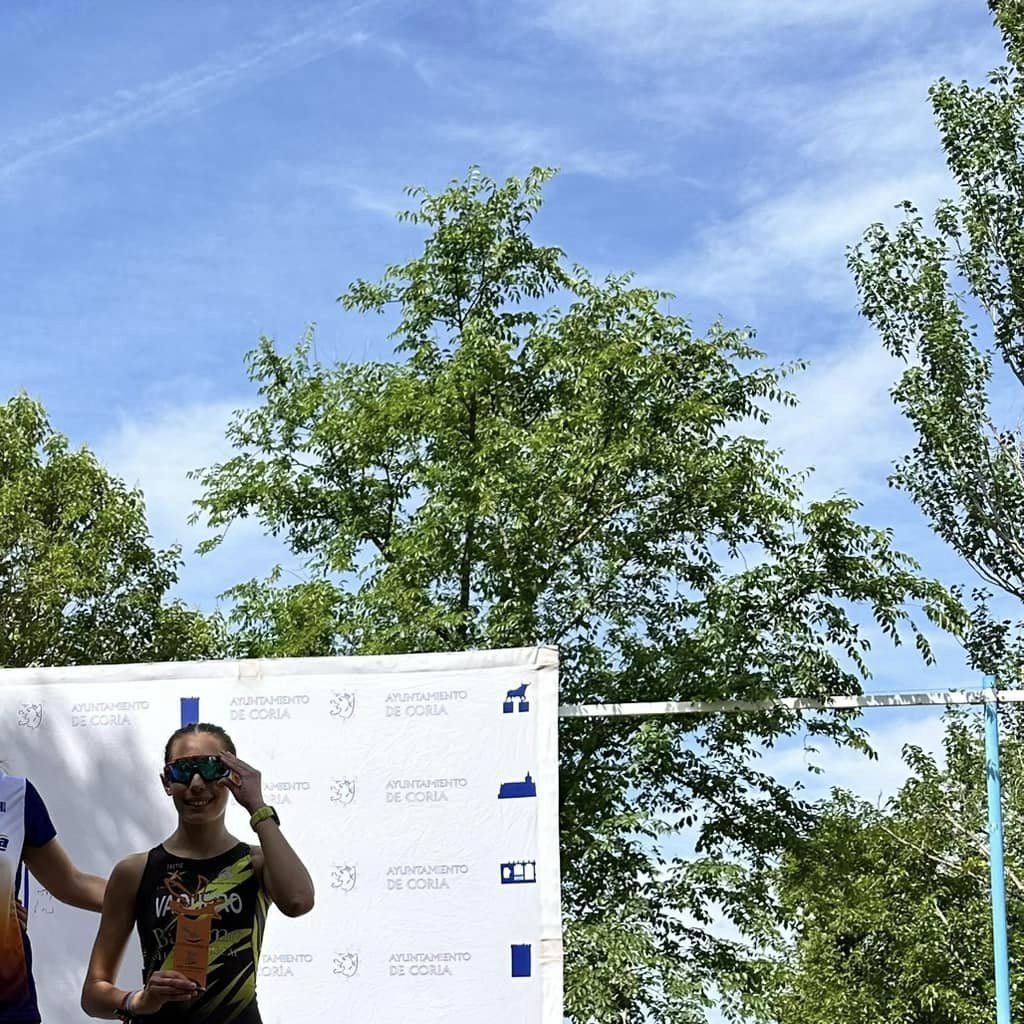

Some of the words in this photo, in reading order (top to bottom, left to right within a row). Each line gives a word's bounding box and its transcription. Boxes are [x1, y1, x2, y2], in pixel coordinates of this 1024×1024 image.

[230, 695, 310, 706] AYUNTAMIENTO
[385, 690, 468, 703] AYUNTAMIENTO
[72, 700, 149, 712] AYUNTAMIENTO
[385, 704, 400, 718] DE
[404, 704, 448, 718] CORIA
[230, 708, 245, 721] DE
[249, 708, 291, 721] CORIA
[72, 715, 86, 727] DE
[90, 715, 132, 727] CORIA
[385, 778, 468, 790] AYUNTAMIENTO
[386, 791, 401, 803] DE
[405, 791, 448, 803] CORIA
[387, 865, 469, 876] AYUNTAMIENTO
[387, 879, 402, 890] DE
[406, 879, 450, 890] CORIA
[388, 952, 471, 963] AYUNTAMIENTO
[389, 965, 404, 976] DE
[408, 965, 452, 976] CORIA
